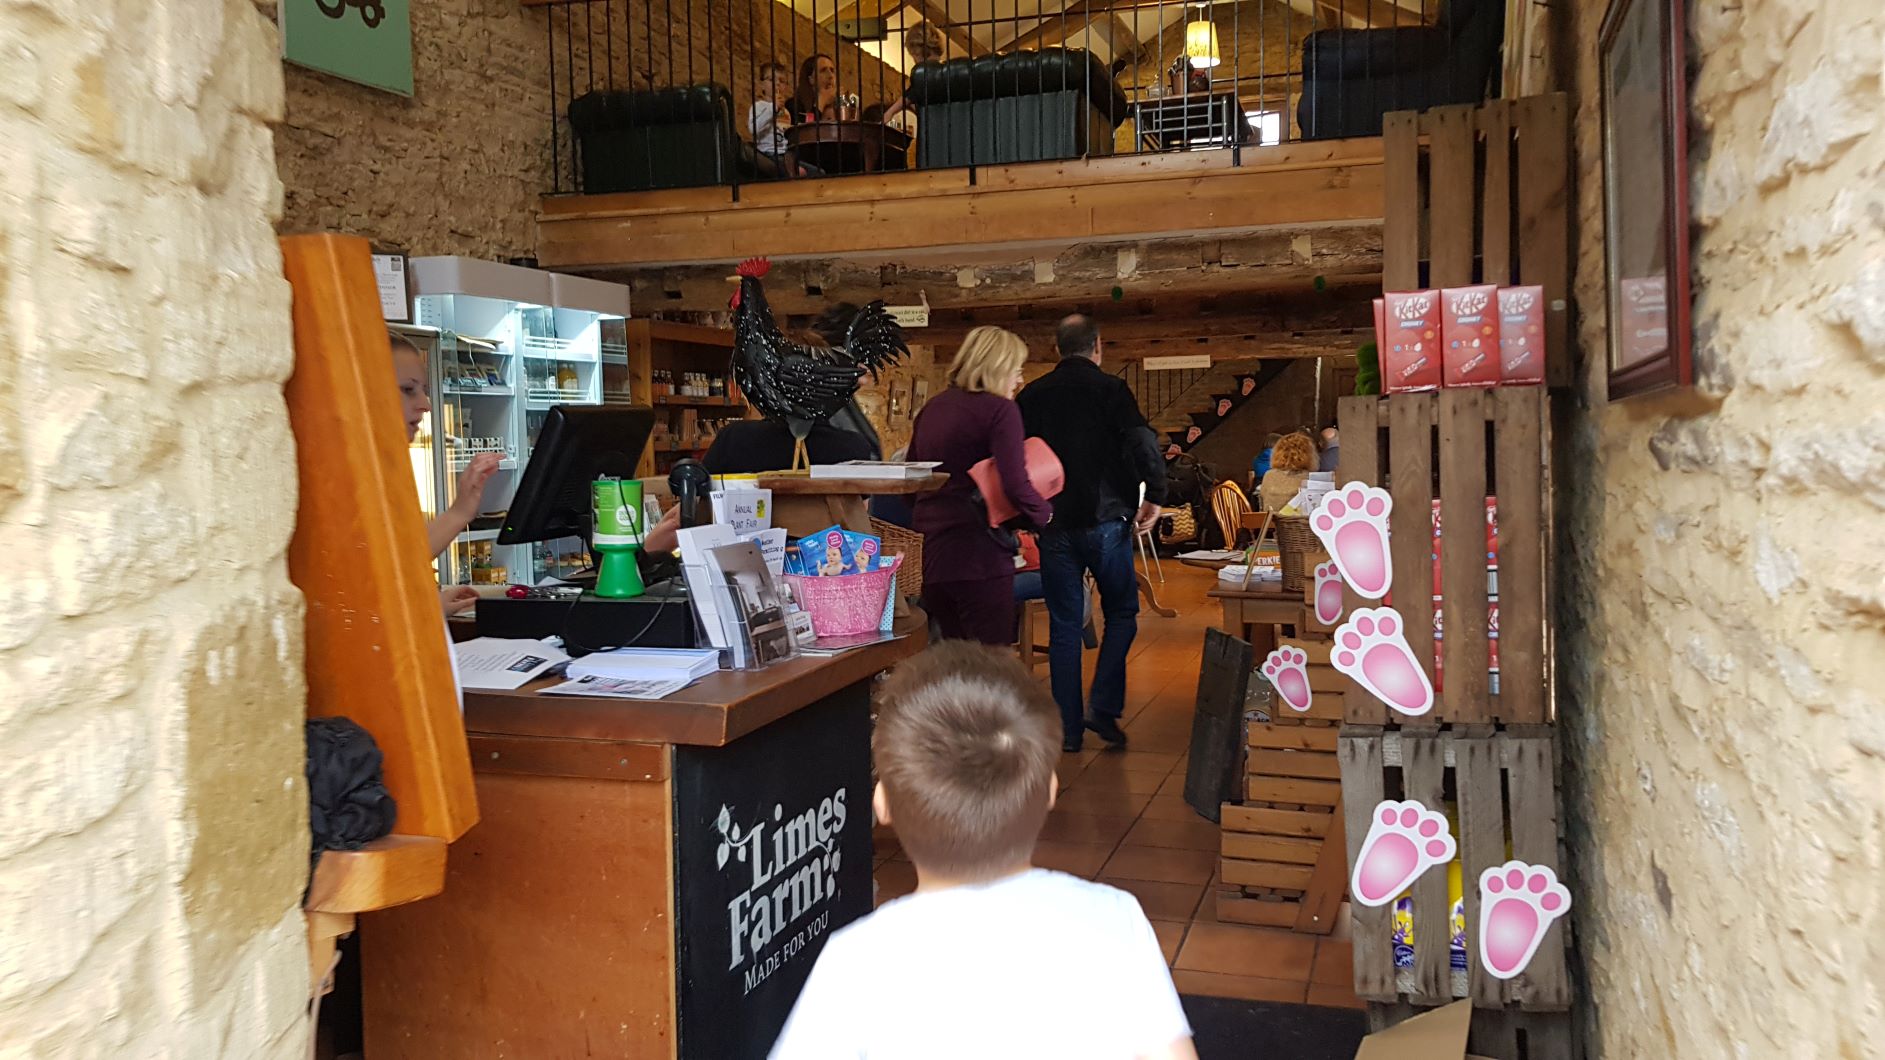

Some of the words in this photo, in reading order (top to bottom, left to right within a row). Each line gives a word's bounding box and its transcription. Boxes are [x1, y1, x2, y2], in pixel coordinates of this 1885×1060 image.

[1395, 296, 1431, 320] KitKat
[1453, 292, 1488, 315] KitKat
[735, 504, 753, 514] ANNUAL
[1257, 555, 1280, 566] ERKIE
[751, 788, 847, 892] Limes
[728, 857, 823, 971] Farm
[744, 950, 780, 995] MADE
[783, 932, 806, 962] FOR
[807, 910, 829, 941] YOU
